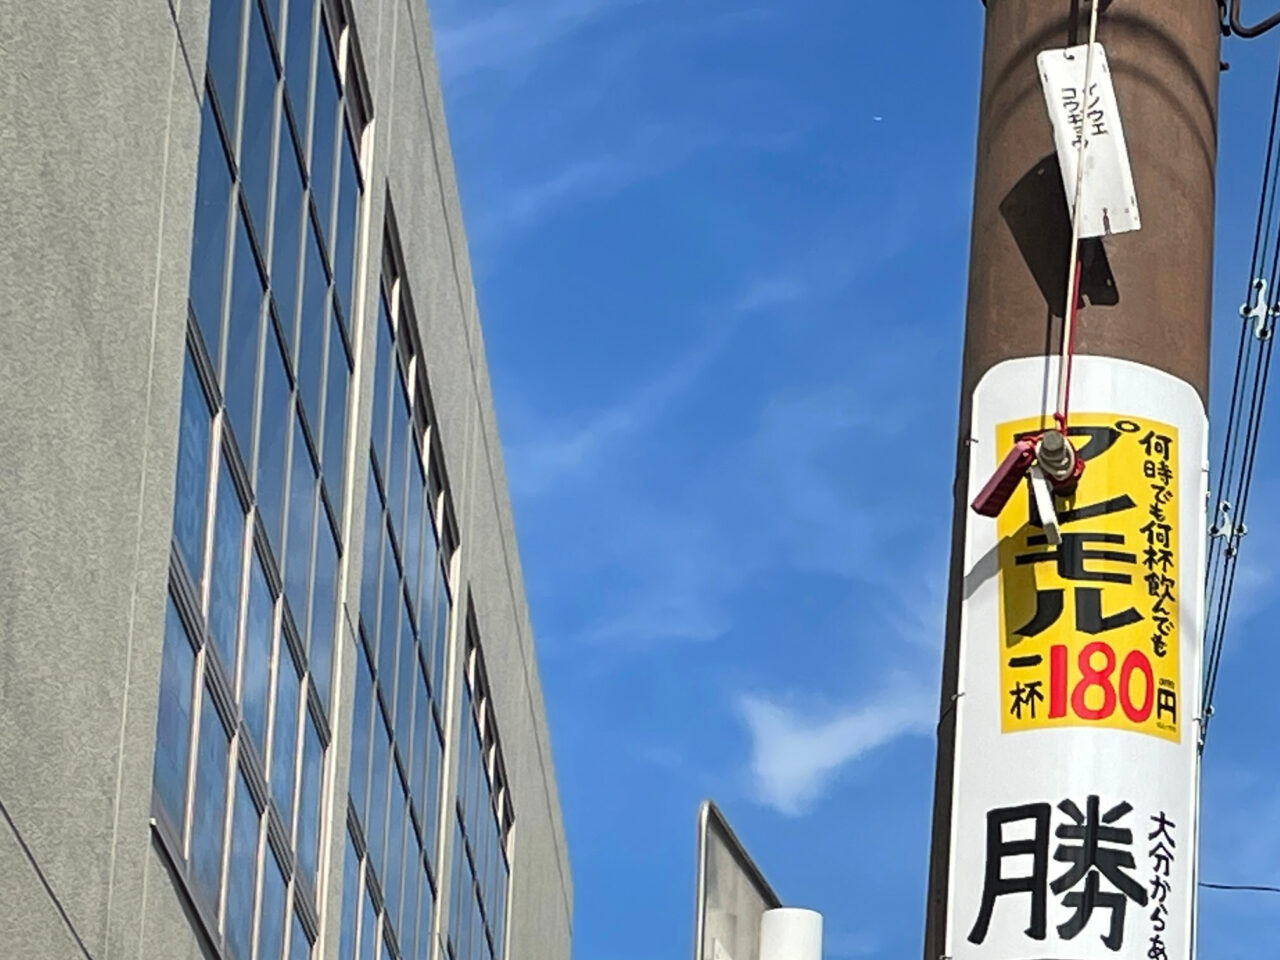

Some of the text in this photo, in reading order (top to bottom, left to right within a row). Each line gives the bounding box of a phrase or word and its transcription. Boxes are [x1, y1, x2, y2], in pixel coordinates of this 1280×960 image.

[1138, 430, 1176, 657] 何時でも何杯飲んでも
[1048, 641, 1155, 723] 180
[1156, 687, 1177, 725] 円
